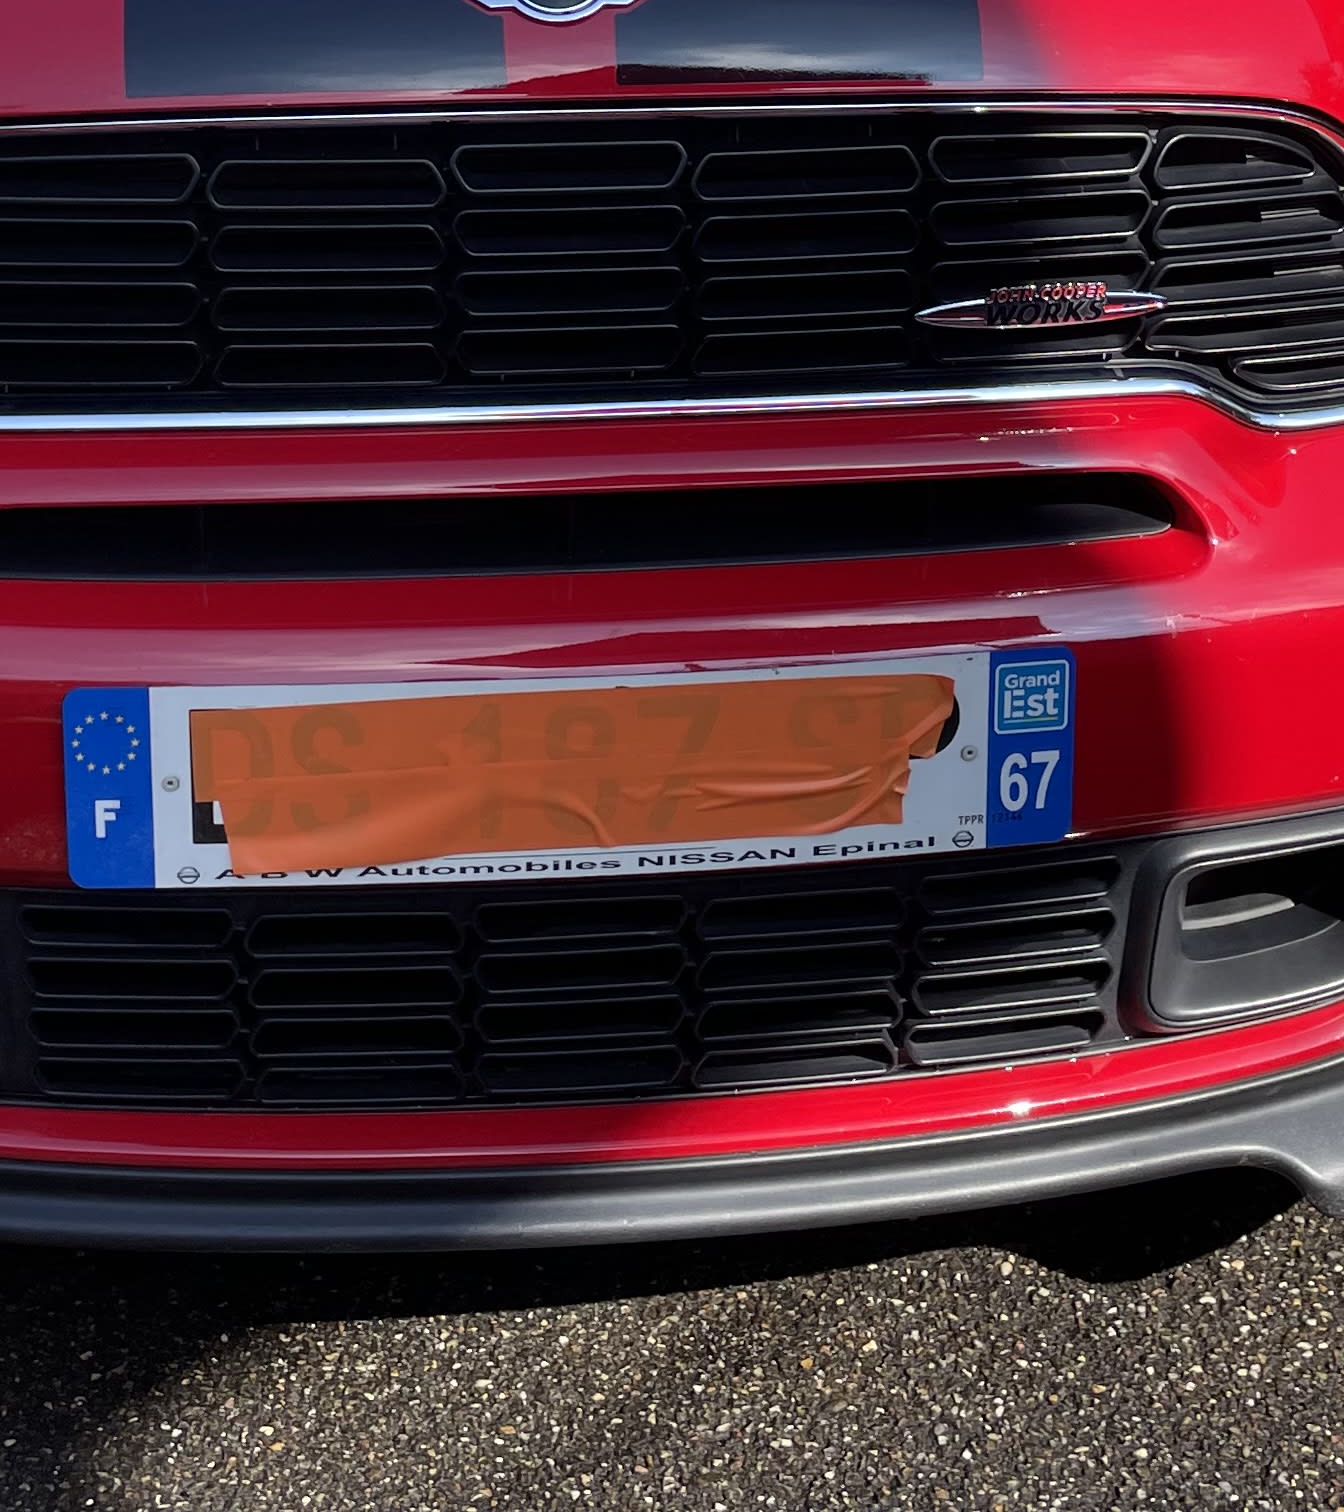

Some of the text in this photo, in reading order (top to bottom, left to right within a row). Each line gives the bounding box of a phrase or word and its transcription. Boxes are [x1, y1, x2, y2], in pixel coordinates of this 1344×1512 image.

[986, 300, 1104, 326] WORKS
[1004, 670, 1060, 688] Grand
[1003, 688, 1059, 719] Est
[999, 750, 1060, 812] 67
[94, 799, 121, 838] F
[357, 858, 621, 877] Automobiles
[638, 847, 796, 867] NISSAN
[813, 836, 935, 857] Epinal
